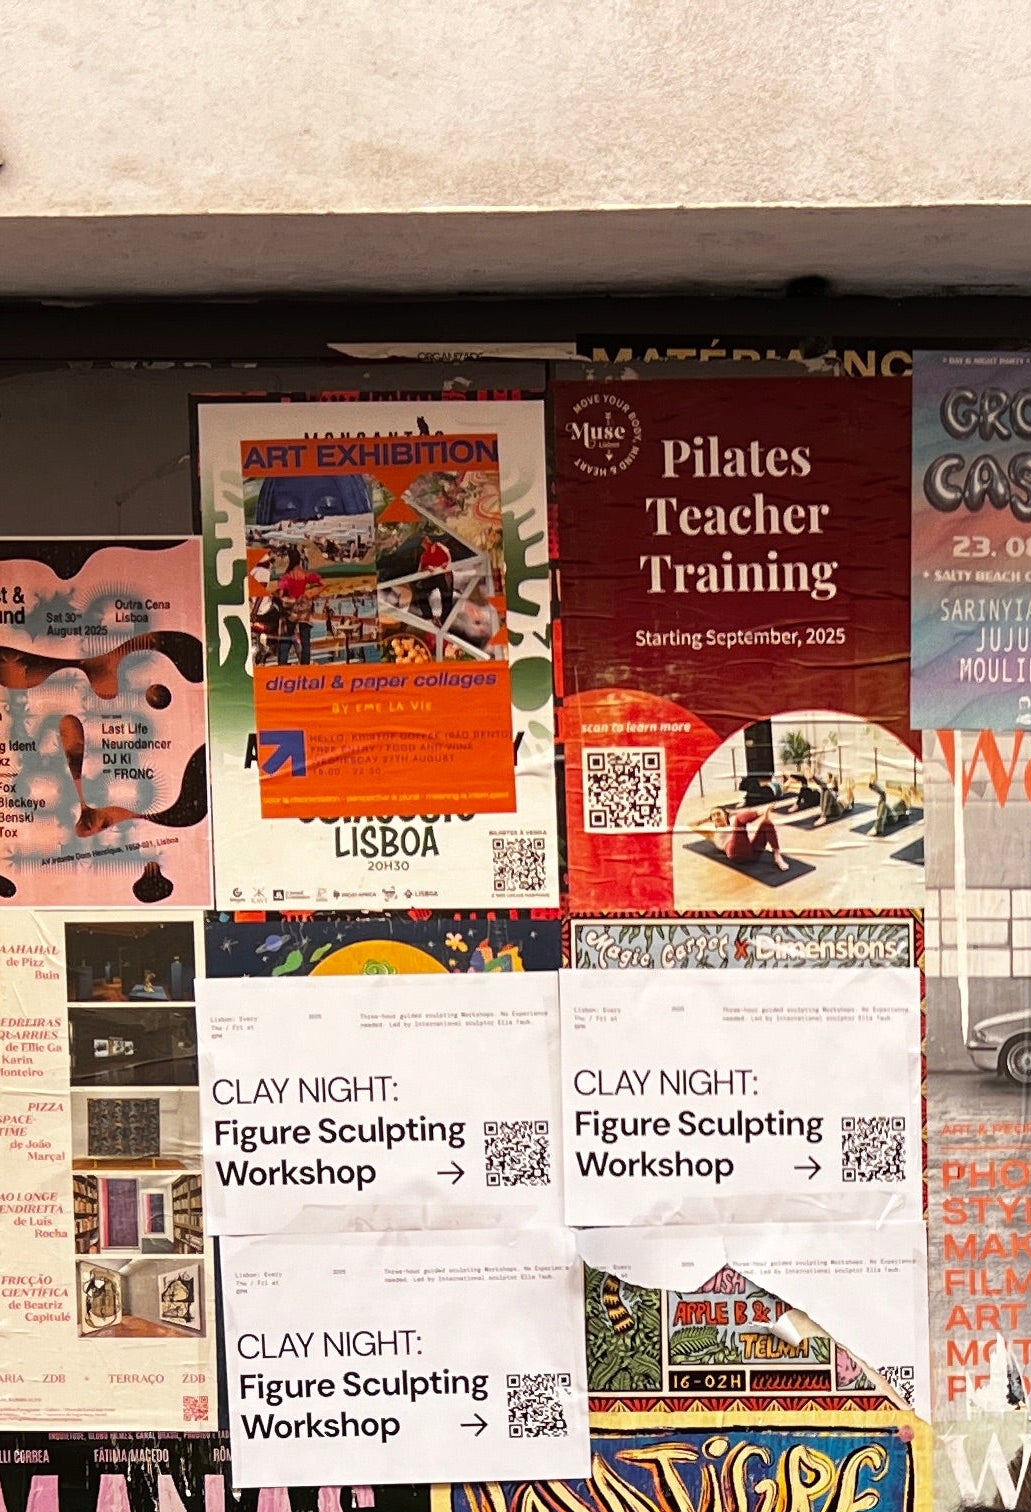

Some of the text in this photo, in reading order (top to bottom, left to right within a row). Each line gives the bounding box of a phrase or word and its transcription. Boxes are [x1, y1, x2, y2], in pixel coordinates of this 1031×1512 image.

[565, 422, 625, 449] Muse
[572, 394, 630, 476] MOVE YOUR HEART
[244, 440, 498, 469] ART EXHIBITION
[661, 435, 811, 478] Pilates
[645, 493, 829, 535] Teacher
[952, 535, 996, 559] 23.
[640, 550, 839, 601] Training
[934, 571, 971, 583] SALTY
[975, 571, 1020, 583] BEACH
[115, 600, 170, 611] Outra Cena
[46, 613, 62, 623] Sat
[115, 612, 149, 623] Lisboa
[47, 626, 108, 637] August 2025
[635, 628, 845, 649] Starting September, 2025
[976, 628, 1029, 652] JUJU
[266, 672, 497, 691] digital & paper collages
[102, 724, 148, 734] Last Life
[582, 721, 691, 732] scan to learn more
[9, 741, 37, 752] Ident
[102, 739, 171, 750] Neurodancer
[103, 753, 117, 764] DJ
[335, 826, 439, 859] LISBOA
[368, 862, 409, 871] 20H30
[585, 931, 898, 968] Magic Carpet Dimensions
[35, 970, 60, 980] Buin
[2, 1055, 33, 1065] Karin
[213, 1075, 399, 1105] CLAY NIGHT:
[574, 1069, 758, 1096] CLAY NIGHT:
[28, 1103, 64, 1112] PIZZA
[214, 1116, 466, 1152] Figure Sculpting
[575, 1110, 823, 1143] Figure Sculpting
[25, 1139, 51, 1148] João
[28, 1152, 65, 1161] Marçal
[215, 1159, 376, 1191] Workshop
[575, 1151, 734, 1183] Workshop
[35, 1229, 67, 1238] Rocha
[1, 1276, 52, 1288] FRICÇÃO
[2, 1287, 68, 1297] CIENTÍFICA
[24, 1300, 63, 1310] Beatriz
[673, 1300, 771, 1326] APPLE B &
[25, 1312, 71, 1322] Capitulé
[945, 1304, 1019, 1331] ART
[237, 1330, 422, 1359] CLAY NIGHT:
[740, 1332, 809, 1359] TELMA
[42, 1374, 205, 1385] ZDB TERRAÇO ZDB
[240, 1369, 489, 1406] Figure Sculpting
[672, 1374, 741, 1388] 16-02H
[241, 1412, 400, 1442] Workshop
